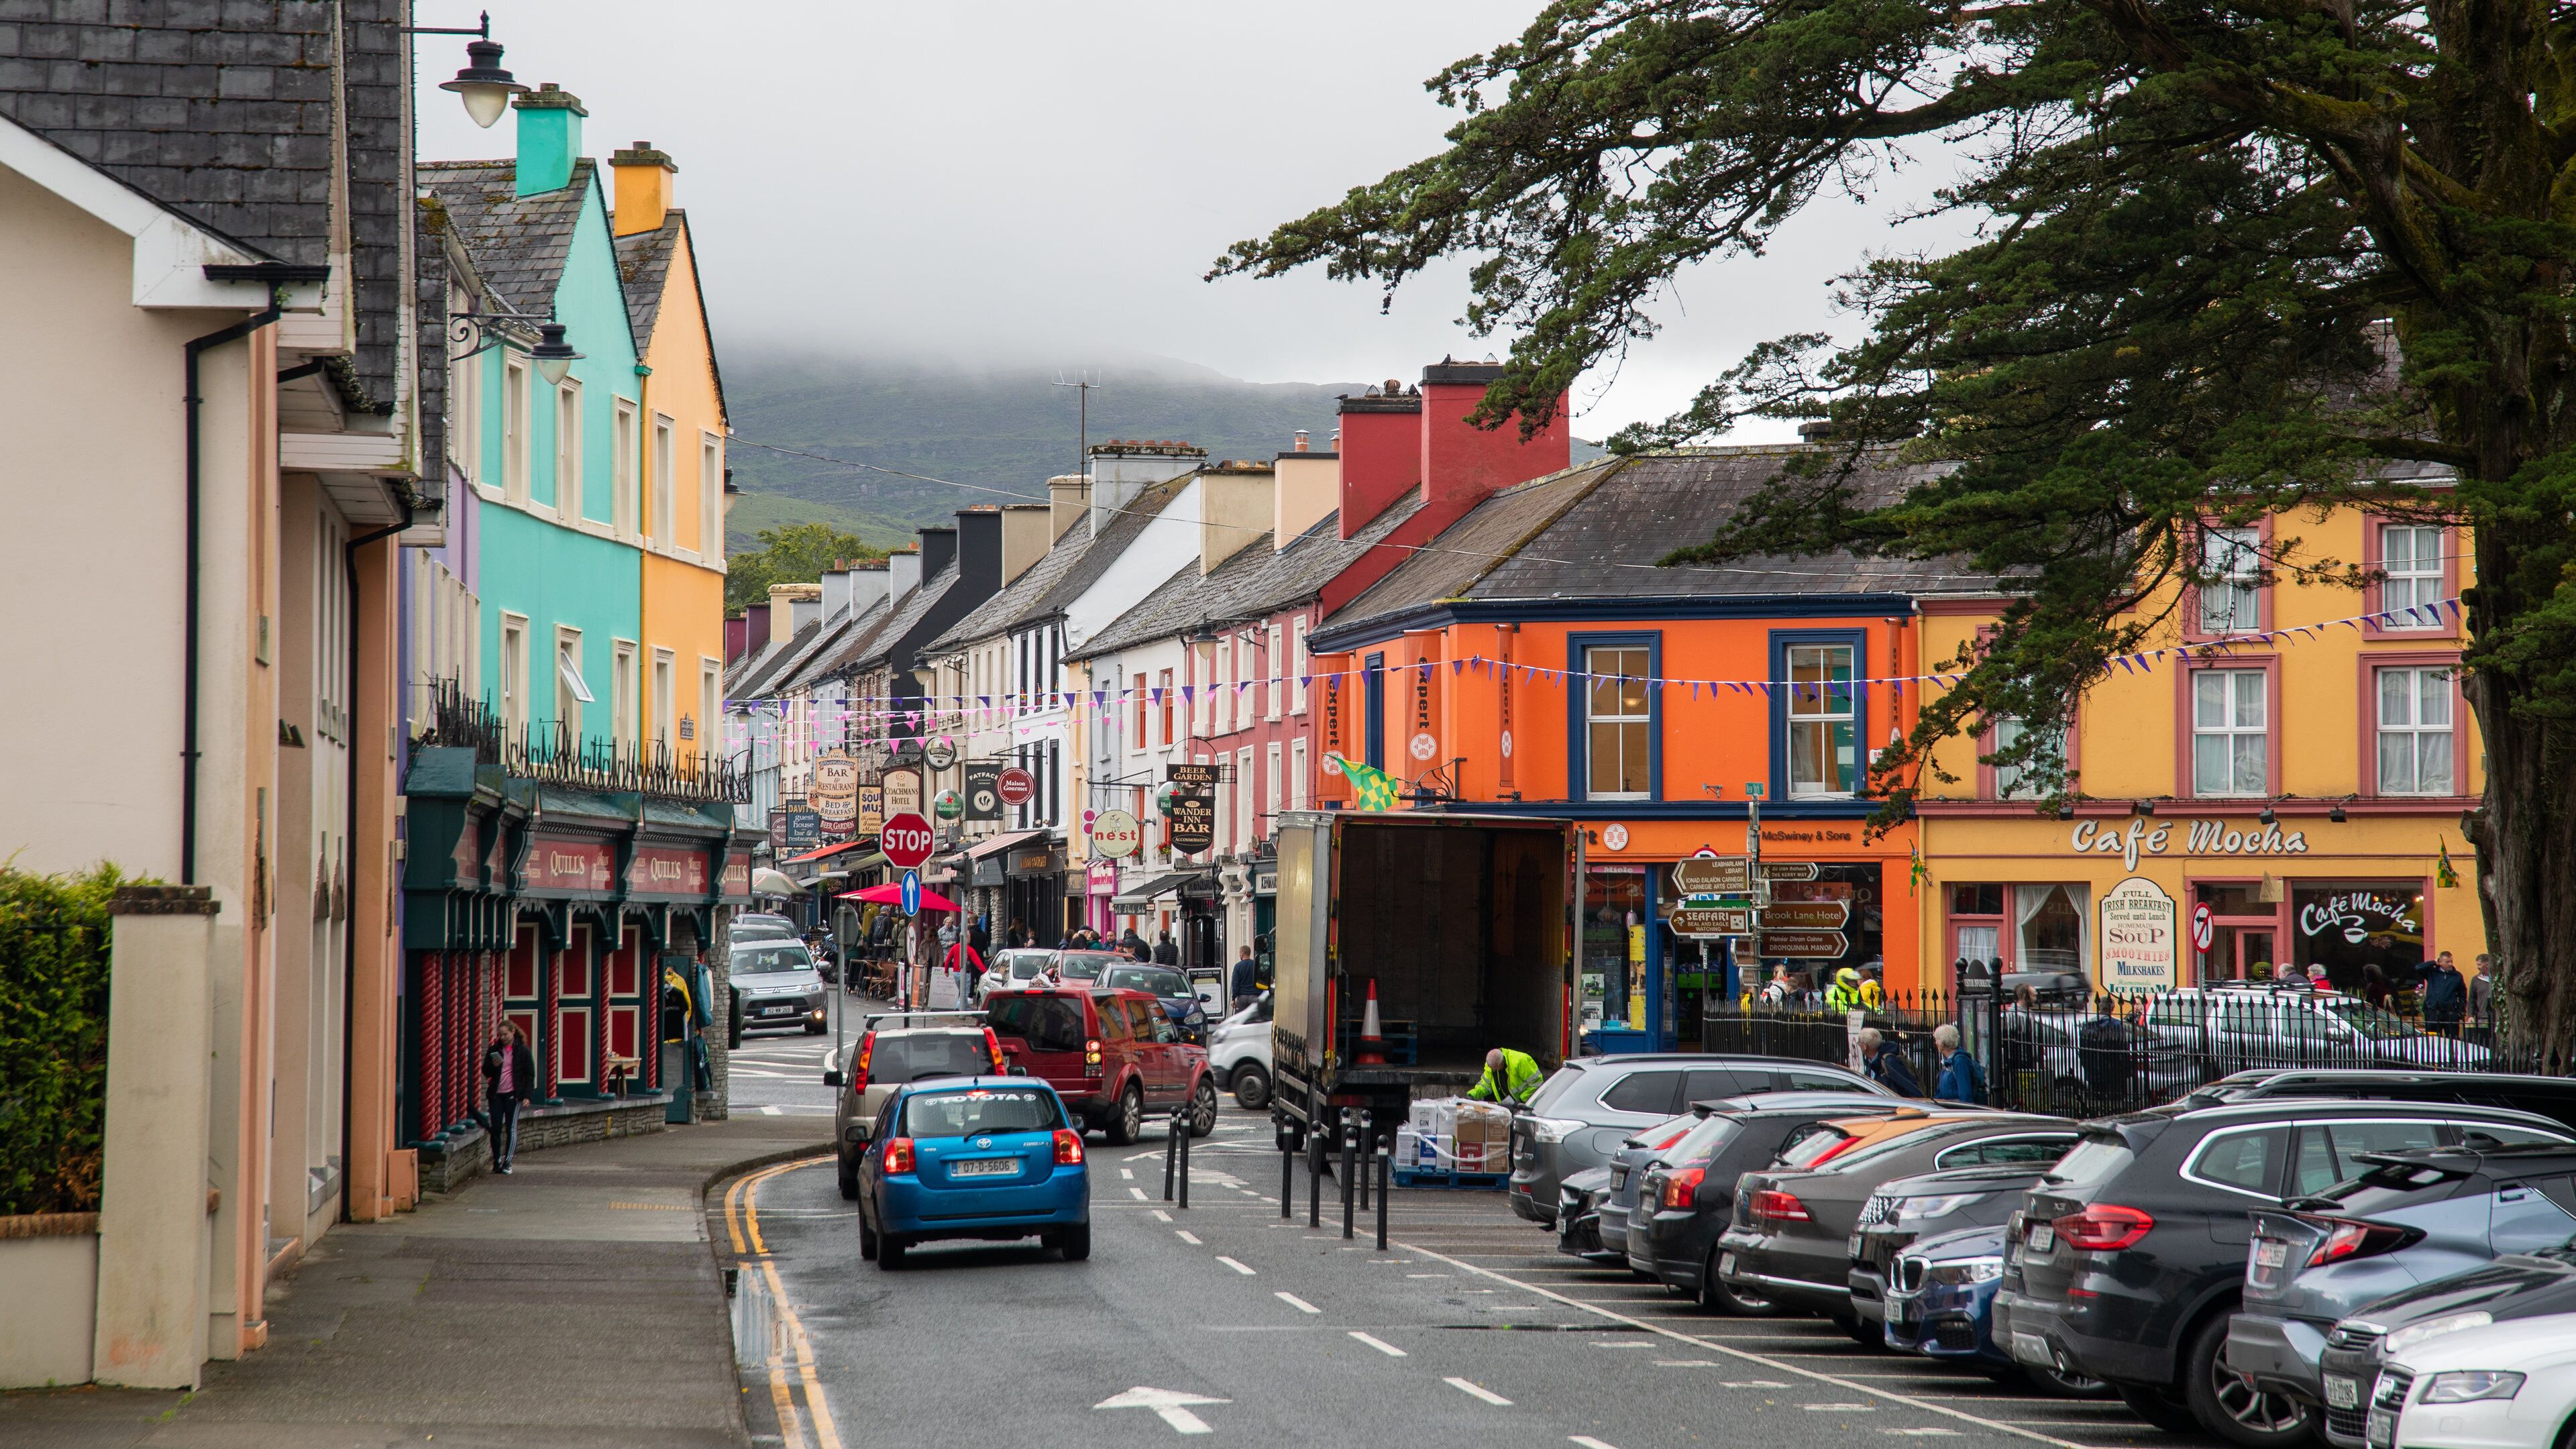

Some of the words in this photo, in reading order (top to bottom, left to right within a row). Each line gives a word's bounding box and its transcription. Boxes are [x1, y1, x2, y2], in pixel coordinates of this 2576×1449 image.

[1419, 656, 1430, 729] expert
[1328, 679, 1339, 747] expert
[827, 767, 848, 777] BAR
[1173, 773, 1212, 781] GARDEN
[818, 781, 856, 791] RESTAURANT
[884, 787, 918, 795] COACHMANS
[861, 793, 881, 802] SOU
[891, 796, 910, 804] HOTEL
[825, 800, 841, 809] BED
[842, 801, 851, 809] &
[820, 807, 855, 815] BREAKFAST
[1173, 808, 1212, 816] WANDER
[794, 814, 814, 822] guest
[820, 820, 833, 829] BEER
[831, 820, 855, 830] GARDEN
[1173, 823, 1211, 833] BAR
[884, 828, 931, 851] STOP
[1095, 830, 1136, 841] nest
[1762, 830, 1813, 843] McSwiney
[1816, 830, 1823, 841] &
[1826, 830, 1851, 841] Sons
[2072, 818, 2174, 873] Café
[2188, 819, 2310, 855] Mocha
[550, 851, 585, 876] QUILL'S
[650, 857, 681, 881] QUILL'S
[2104, 900, 2125, 913] IRISH
[2129, 899, 2171, 913] BREAKFAST
[1686, 912, 1729, 921] SEAFARI
[1765, 910, 1791, 920] Brook
[1794, 911, 1815, 920] Lane
[1817, 911, 1841, 920] Hotel
[2110, 912, 2130, 920] Served
[2133, 912, 2146, 920] until
[2149, 912, 2166, 920] Lunch
[2300, 896, 2348, 936] Café
[2351, 892, 2416, 933] Mocha
[2106, 947, 2170, 962] SMOOTHIES
[2117, 961, 2165, 975] MILKSHAKES
[2109, 983, 2127, 994] ICE
[2130, 984, 2167, 994] CREAM
[941, 1093, 1020, 1104] TOYOTA
[963, 1161, 1010, 1173] 07-D-5606
